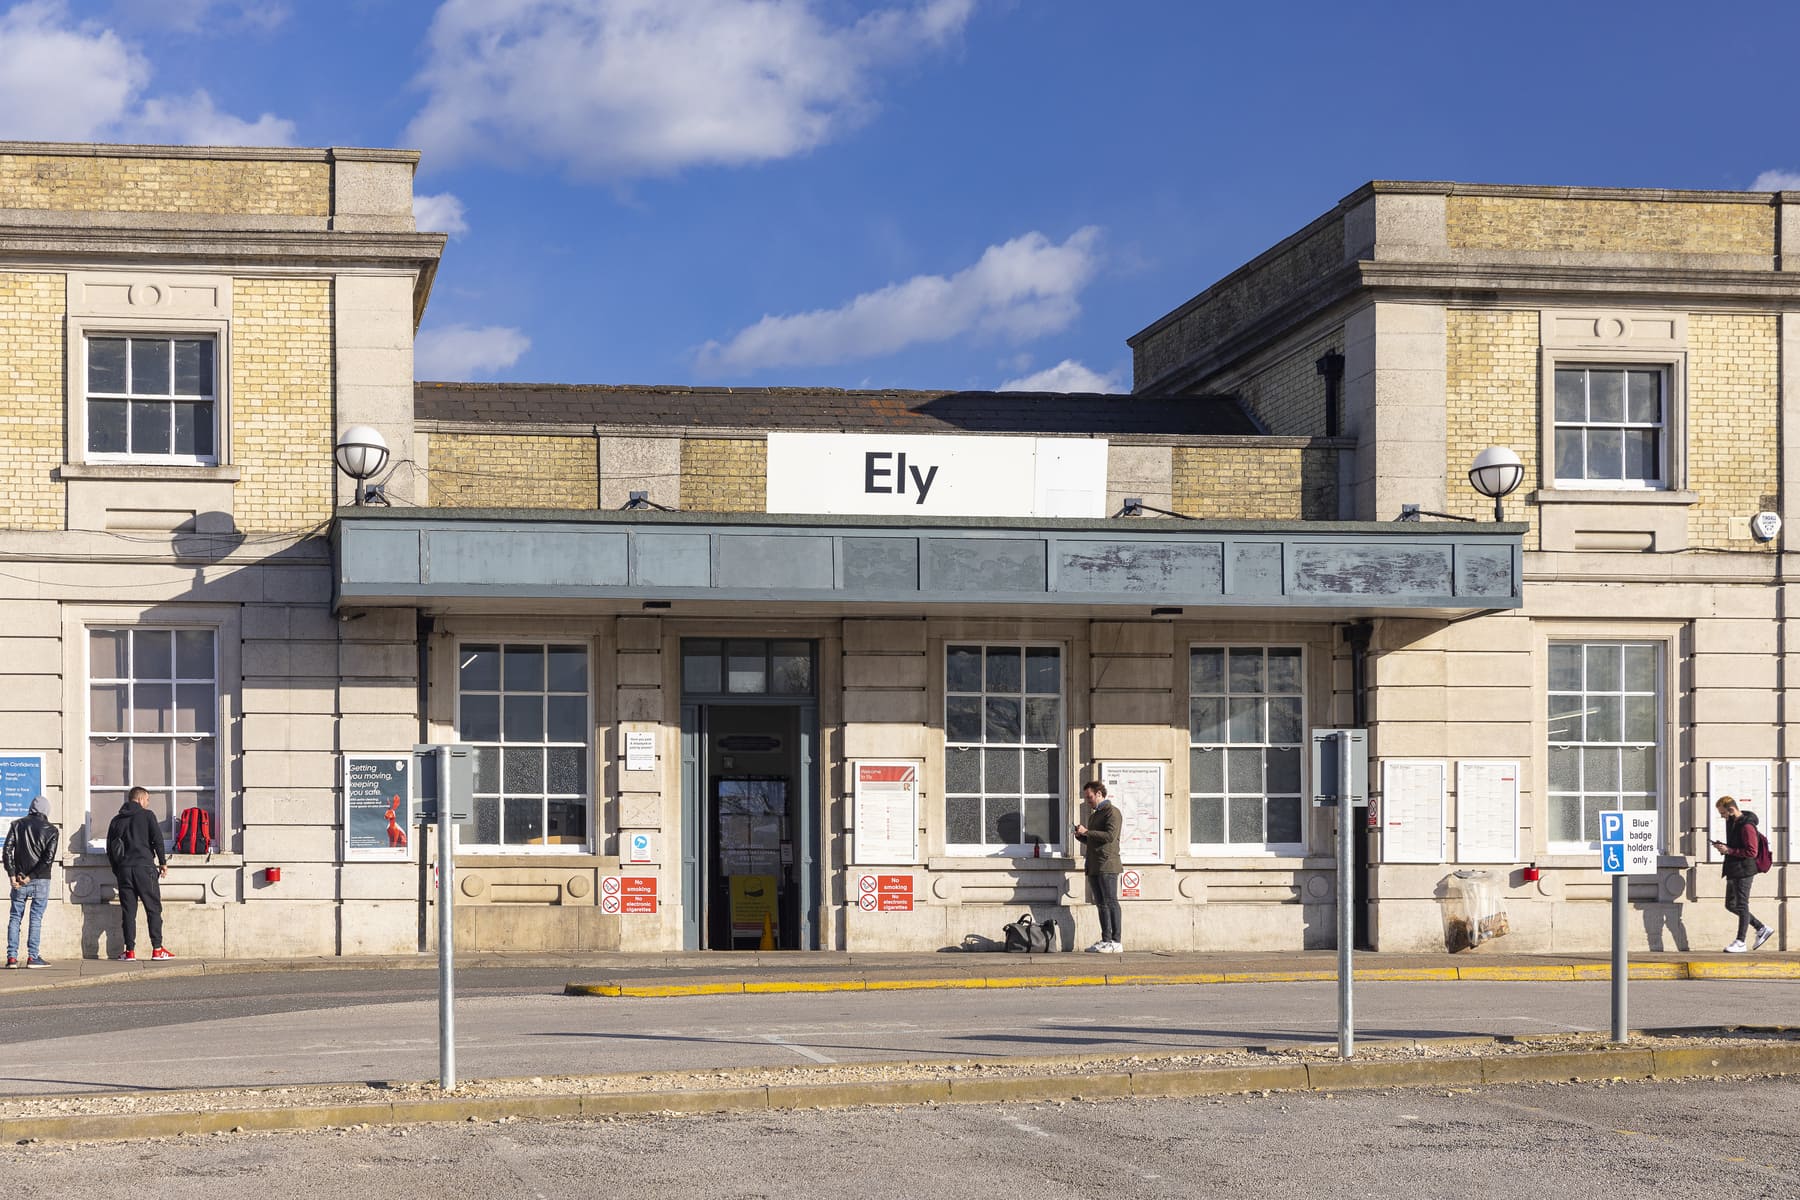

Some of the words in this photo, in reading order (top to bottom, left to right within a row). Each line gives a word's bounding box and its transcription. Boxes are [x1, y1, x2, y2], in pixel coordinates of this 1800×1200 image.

[864, 451, 939, 504] Ely
[350, 764, 377, 773] Getting
[363, 772, 393, 781] moving,
[1605, 815, 1621, 840] P
[1632, 818, 1650, 828] Blue
[1629, 831, 1652, 842] badge
[1627, 843, 1654, 852] holders
[626, 885, 652, 893] smoking
